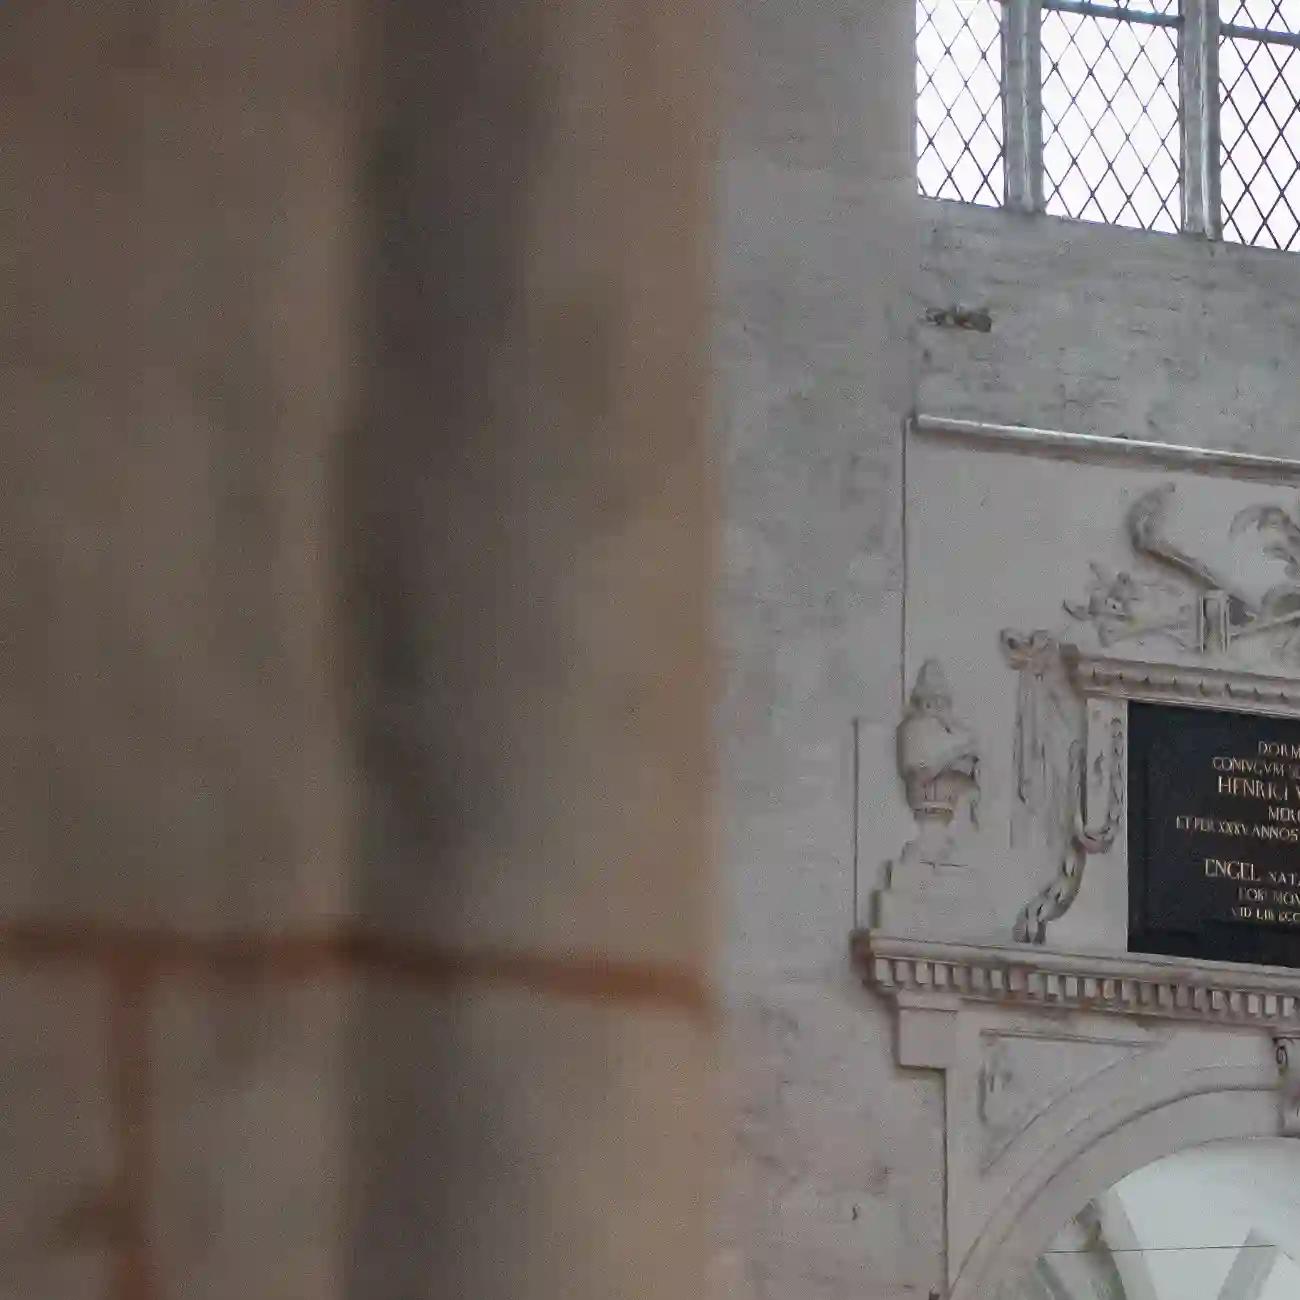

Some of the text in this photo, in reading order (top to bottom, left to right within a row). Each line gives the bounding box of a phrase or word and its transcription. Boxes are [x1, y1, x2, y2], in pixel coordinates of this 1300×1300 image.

[1211, 756, 1285, 777] CONIVGVM
[1217, 775, 1289, 801] HENRICI
[1251, 824, 1299, 842] ANNOS
[1203, 857, 1261, 881] ENGEL
